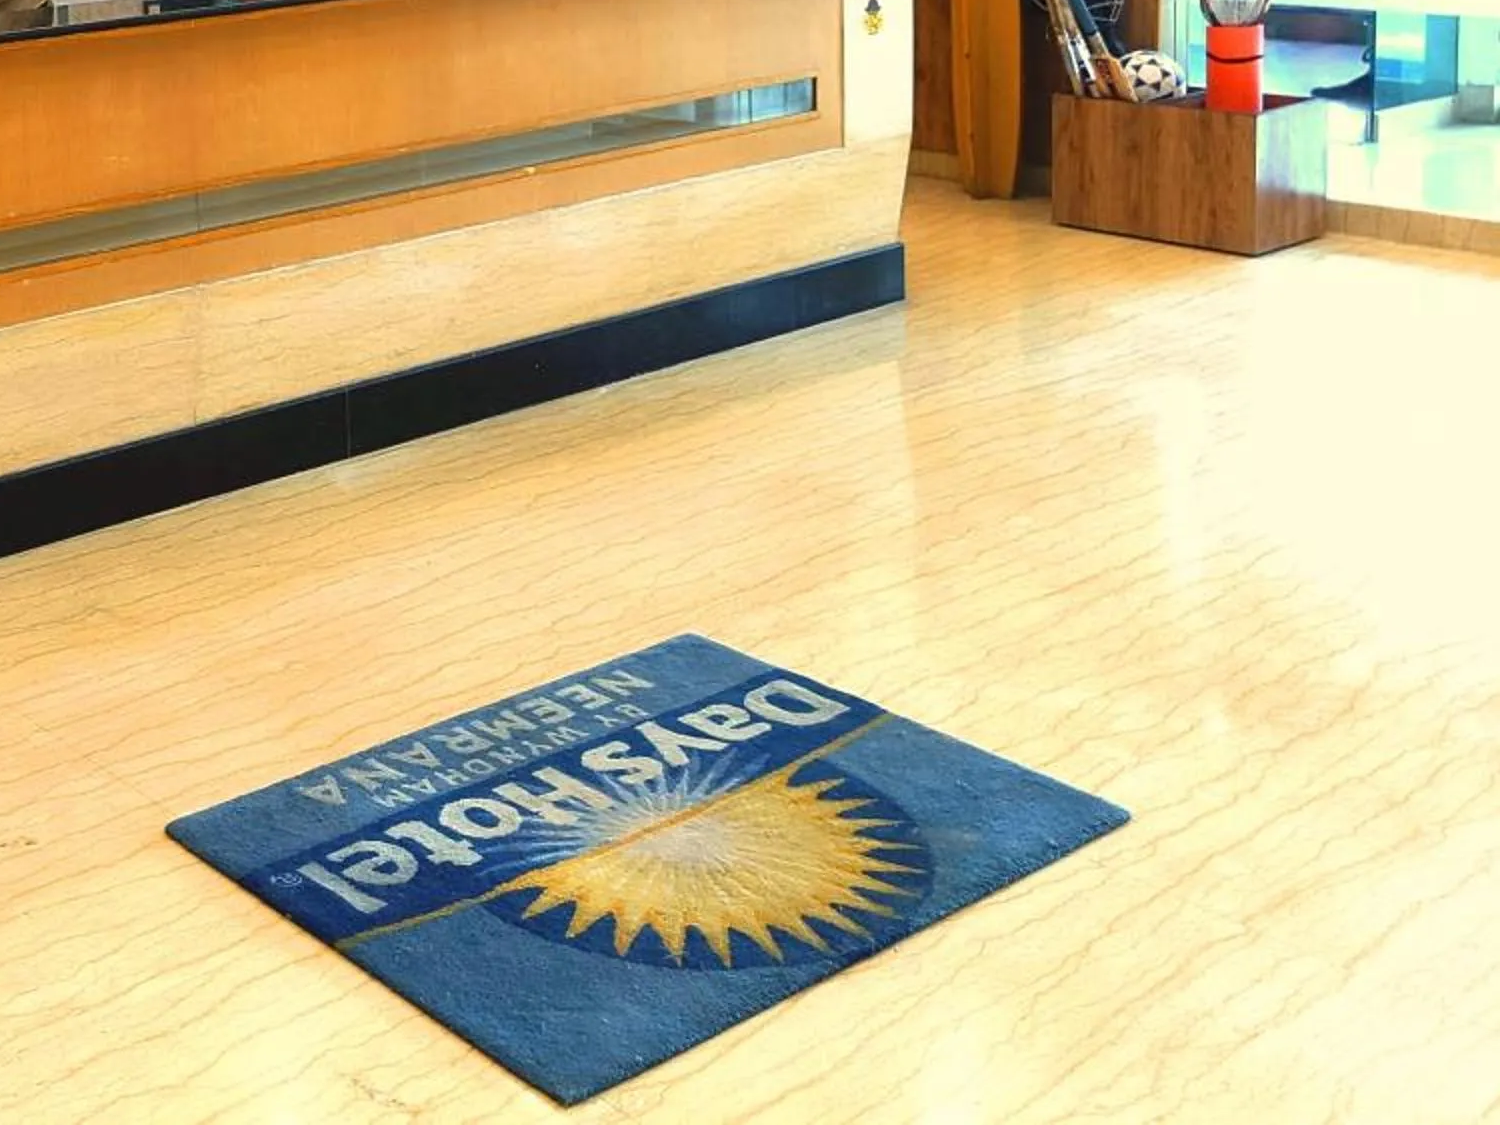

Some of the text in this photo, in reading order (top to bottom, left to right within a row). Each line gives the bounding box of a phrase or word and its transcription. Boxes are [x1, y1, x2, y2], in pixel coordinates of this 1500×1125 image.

[298, 677, 851, 915] Days Hotel
[300, 669, 657, 807] NEEMRANA
[372, 702, 651, 810] BY WYNDHAM
